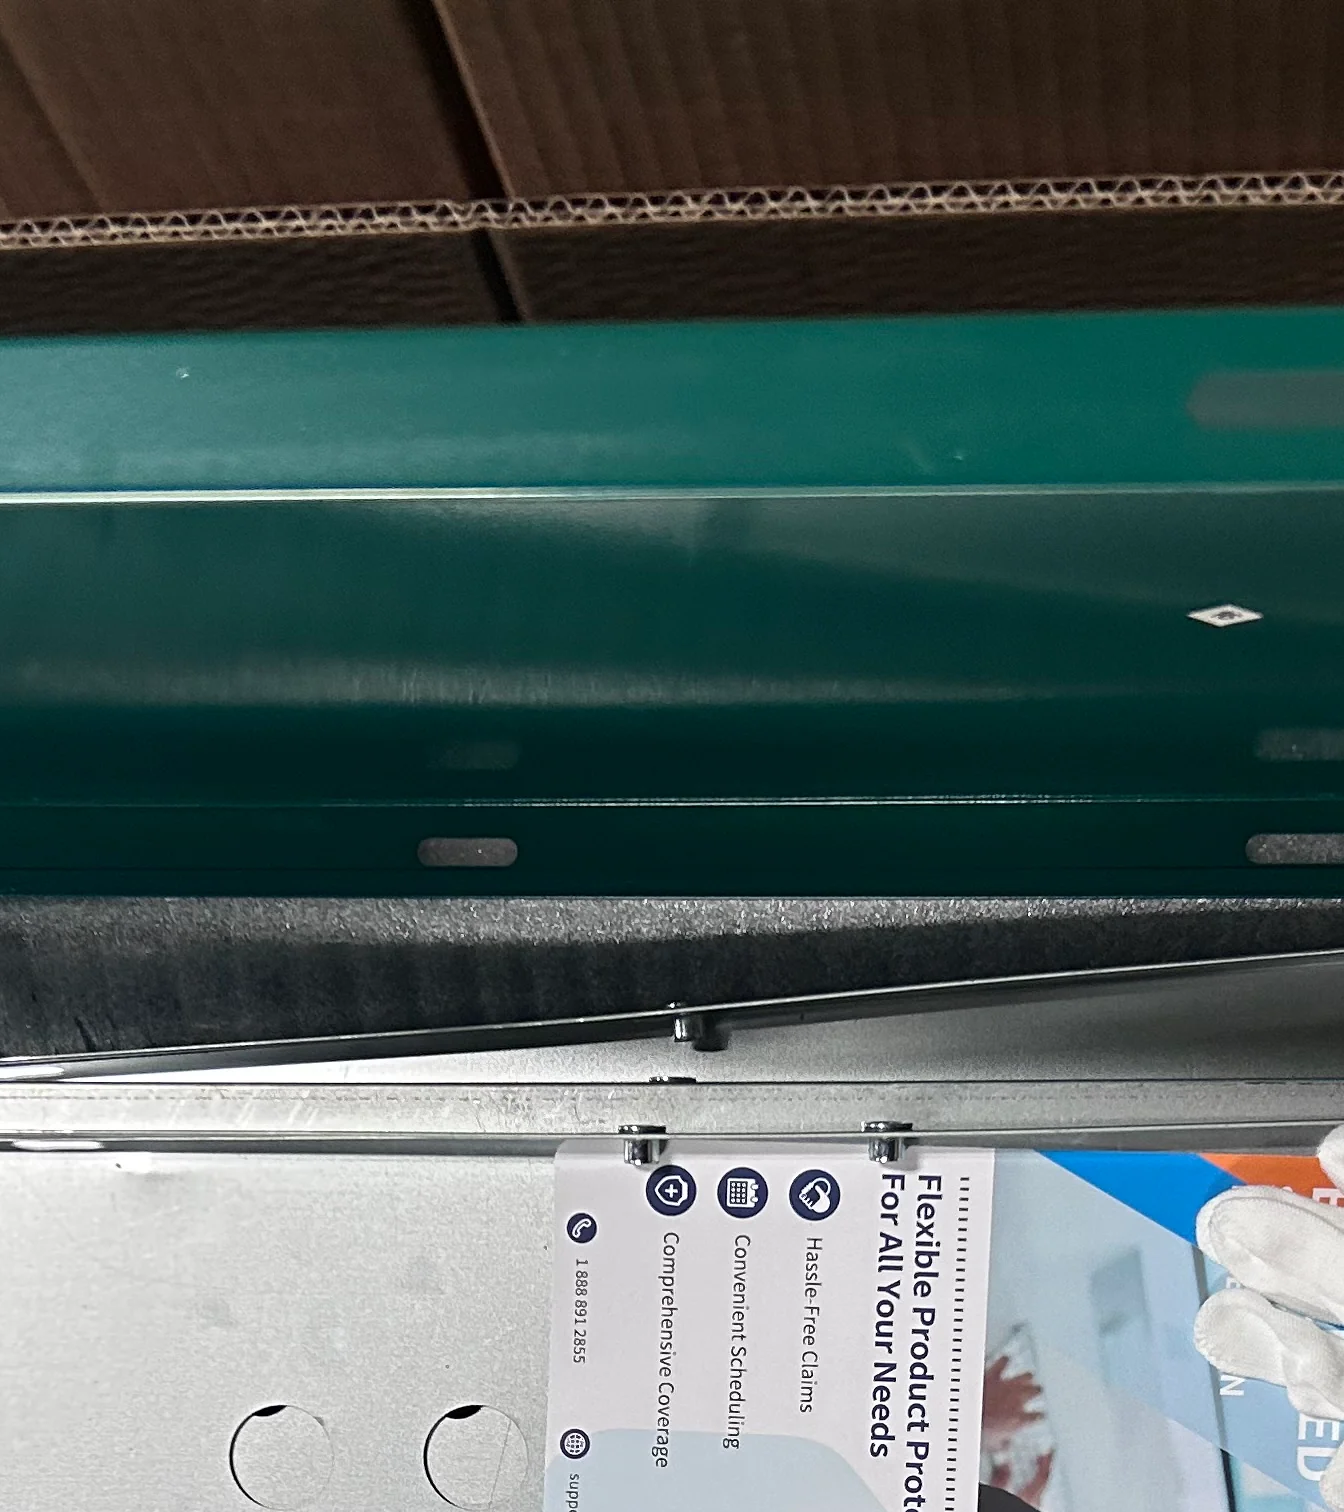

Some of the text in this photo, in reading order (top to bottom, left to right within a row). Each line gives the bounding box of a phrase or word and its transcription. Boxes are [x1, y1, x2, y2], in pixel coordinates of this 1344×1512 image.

[573, 1258, 589, 1364] 1 888 891 2855
[869, 1173, 906, 1458] For All Your Needs
[912, 1174, 943, 1298] Flexible
[651, 1232, 680, 1468] Comprehensive Coverage
[722, 1234, 751, 1450] Convenient Scheduling
[799, 1237, 823, 1413] Hassle-Free Claims
[906, 1307, 936, 1433] Product
